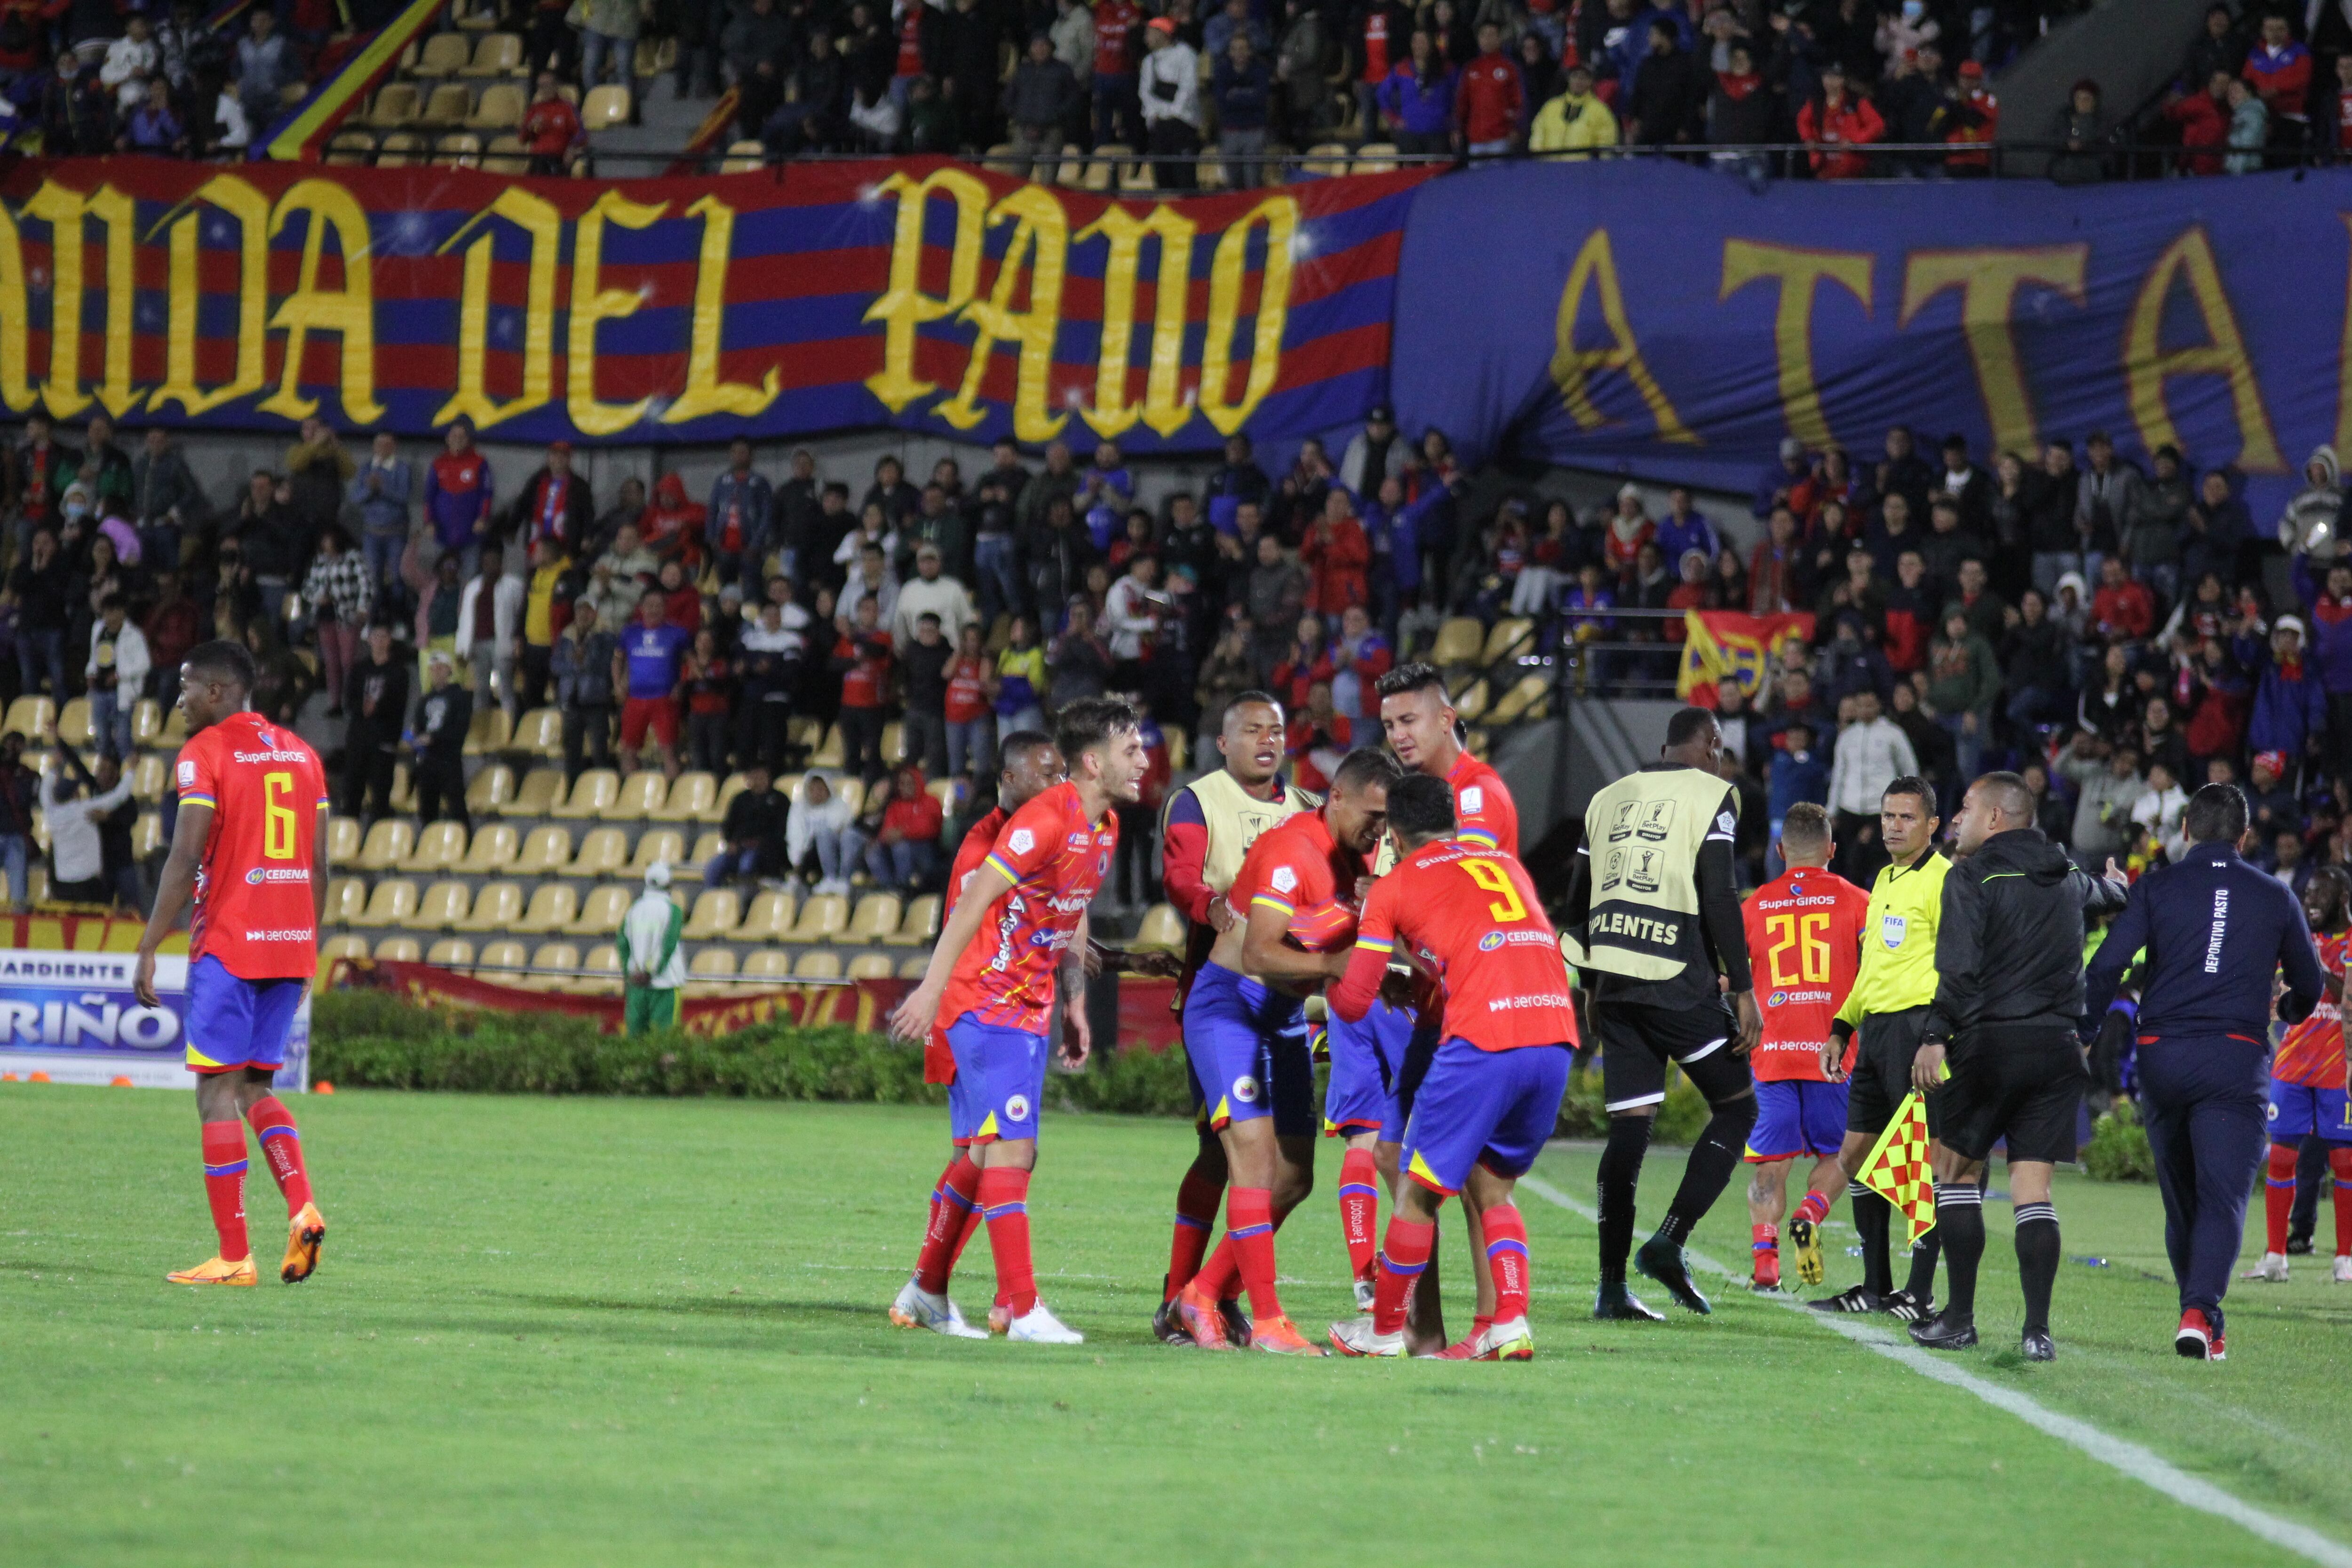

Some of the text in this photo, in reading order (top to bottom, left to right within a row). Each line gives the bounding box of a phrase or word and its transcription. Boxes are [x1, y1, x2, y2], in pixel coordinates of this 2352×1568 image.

[432, 186, 781, 436] DEL
[1548, 210, 2352, 470] ATTA
[234, 750, 306, 764] SuperGIROS
[264, 772, 295, 859] 6
[1642, 822, 1666, 832] BetPlay
[266, 869, 309, 879] CEDENA
[1632, 874, 1654, 883] BetPlay
[1458, 859, 1527, 923] 9
[1759, 895, 1836, 910] SuperGIROS
[1589, 913, 1678, 946] UPLENTES
[1885, 917, 1903, 926] FIFA
[1507, 931, 1555, 946] CEDENAR
[2205, 890, 2228, 973] DEPORTIVO PASTO
[1766, 913, 1830, 987] 26
[1514, 995, 1570, 1010] aerosport
[1789, 991, 1832, 1001] CEDENAR
[1780, 1040, 1827, 1054] aerosp
[2344, 1101, 2352, 1124] 1
[1347, 1199, 1365, 1236] aerosport
[1498, 1257, 1520, 1289] aerosport
